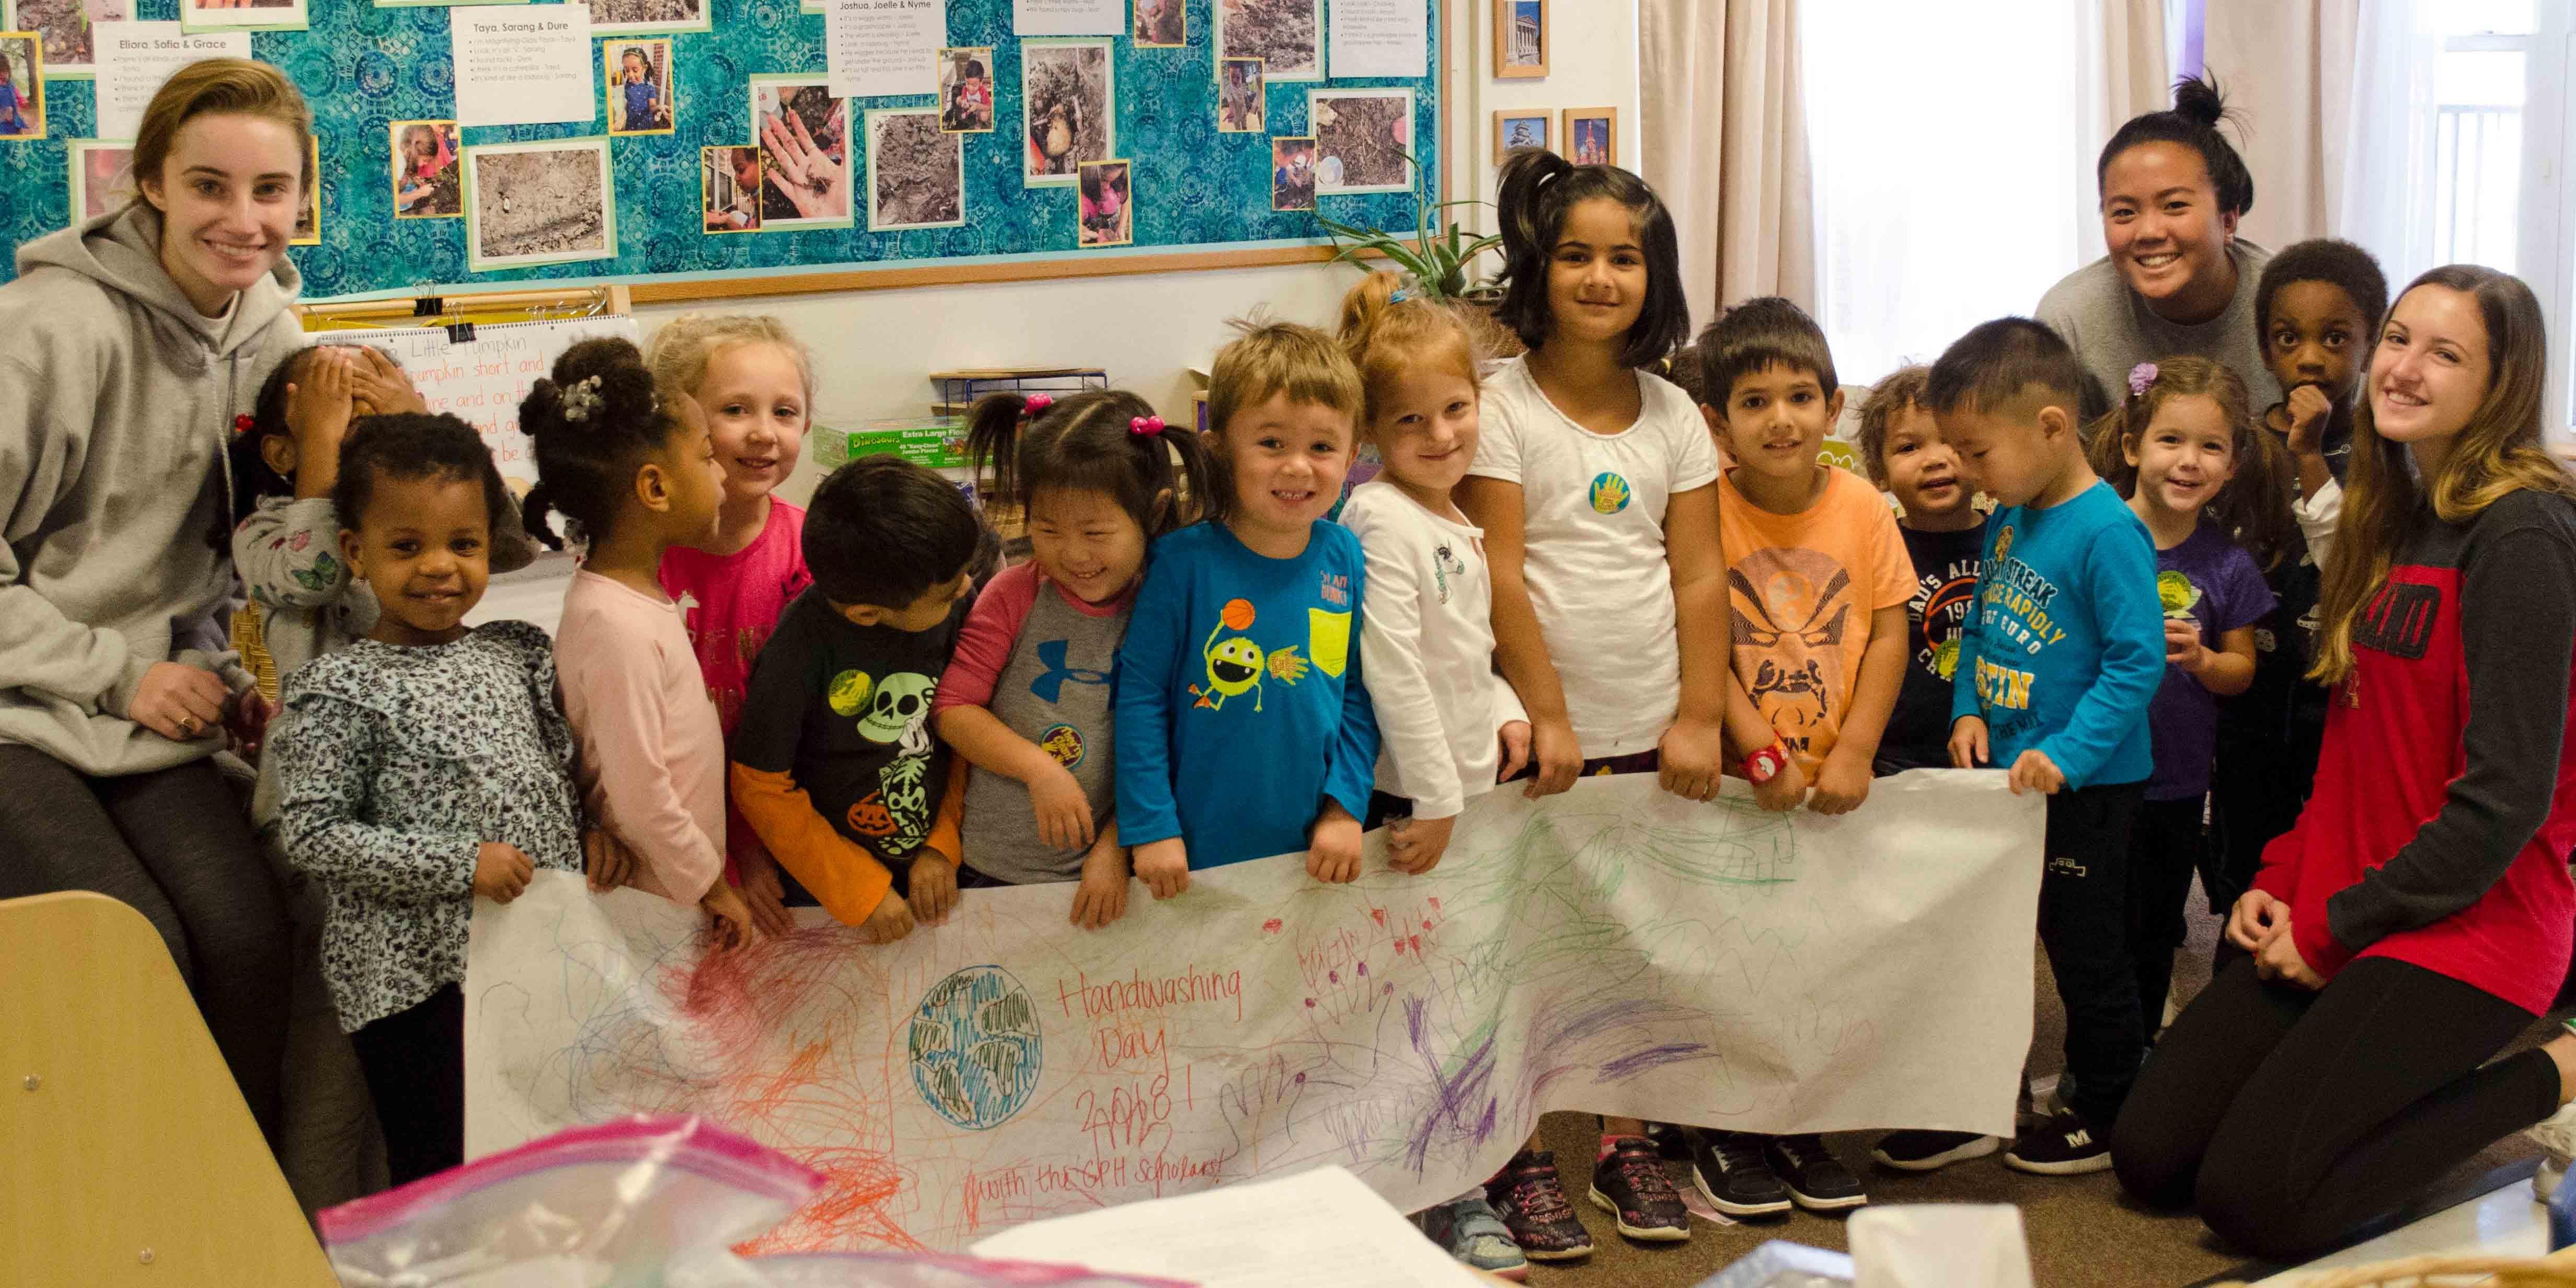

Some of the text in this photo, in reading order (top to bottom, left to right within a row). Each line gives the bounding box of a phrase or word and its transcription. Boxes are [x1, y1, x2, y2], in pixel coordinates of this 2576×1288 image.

[840, 0, 931, 10] Joshua, Joelle & Nyme
[474, 24, 500, 33] Taya,
[502, 23, 535, 33] Sarang
[547, 21, 569, 30] Dure
[119, 40, 226, 50] Eliora, Sofia & Grace
[411, 338, 452, 358] Little
[472, 352, 510, 376] short
[519, 349, 545, 373] and
[456, 384, 485, 407] and
[493, 392, 511, 406] on
[515, 376, 532, 402] th
[925, 429, 947, 438] Large
[501, 439, 519, 461] be
[2005, 557, 2058, 610] STREAK
[1908, 574, 1942, 623] DAD'S
[2005, 586, 2066, 646] RAPIDLY
[1059, 963, 1243, 1023] Handwashing
[1099, 1026, 1171, 1083] Day
[2064, 1129, 2092, 1147] M
[1082, 1156, 1126, 1189] GPH
